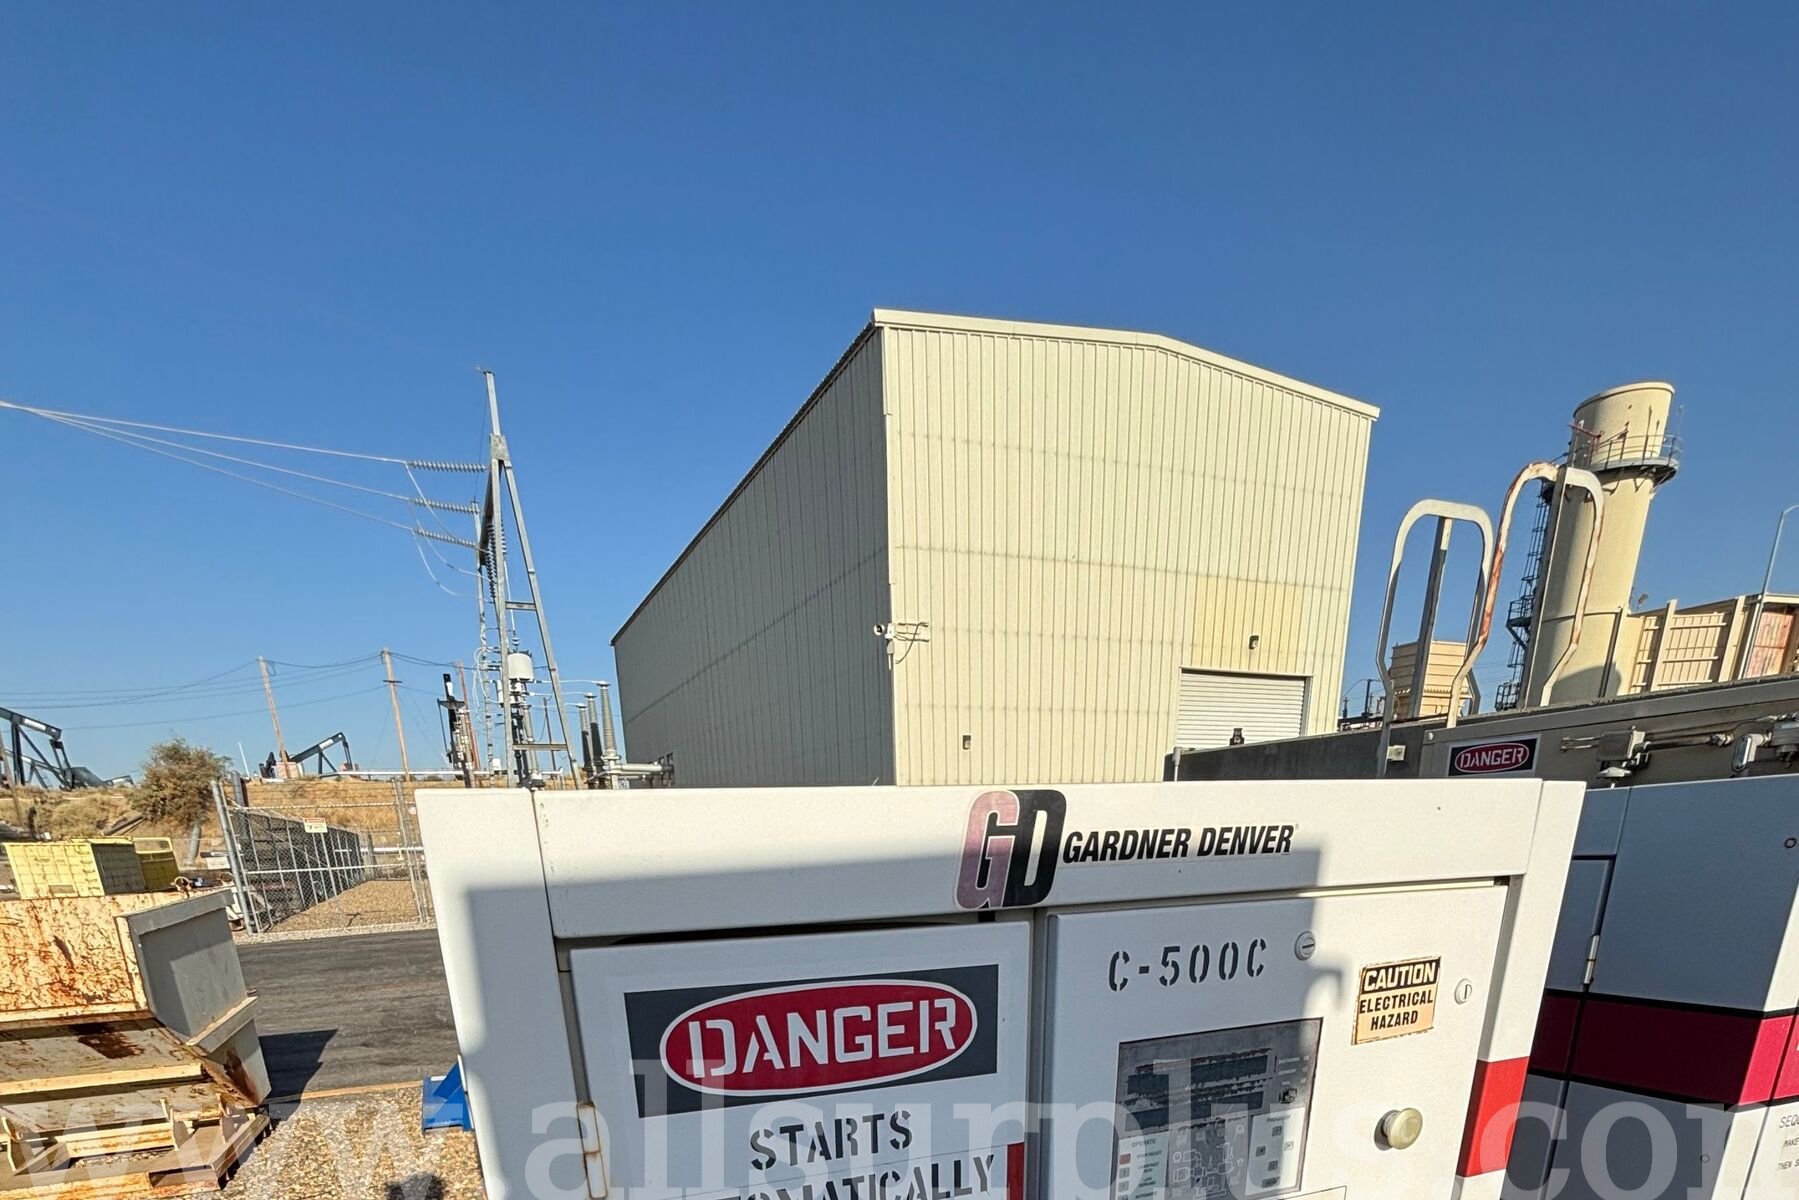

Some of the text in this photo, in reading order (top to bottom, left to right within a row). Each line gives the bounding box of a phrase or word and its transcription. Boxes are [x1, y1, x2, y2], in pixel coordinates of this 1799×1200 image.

[1460, 748, 1524, 768] DANGER
[1063, 824, 1294, 864] GARDNER DENVER
[1109, 939, 1266, 992] C-500C
[1364, 962, 1436, 992] CAUTION
[1359, 990, 1433, 1014] ELECTRICAL
[688, 998, 956, 1078] DANGER
[1370, 1010, 1418, 1031] HAZARD
[750, 1110, 912, 1170] STARTS
